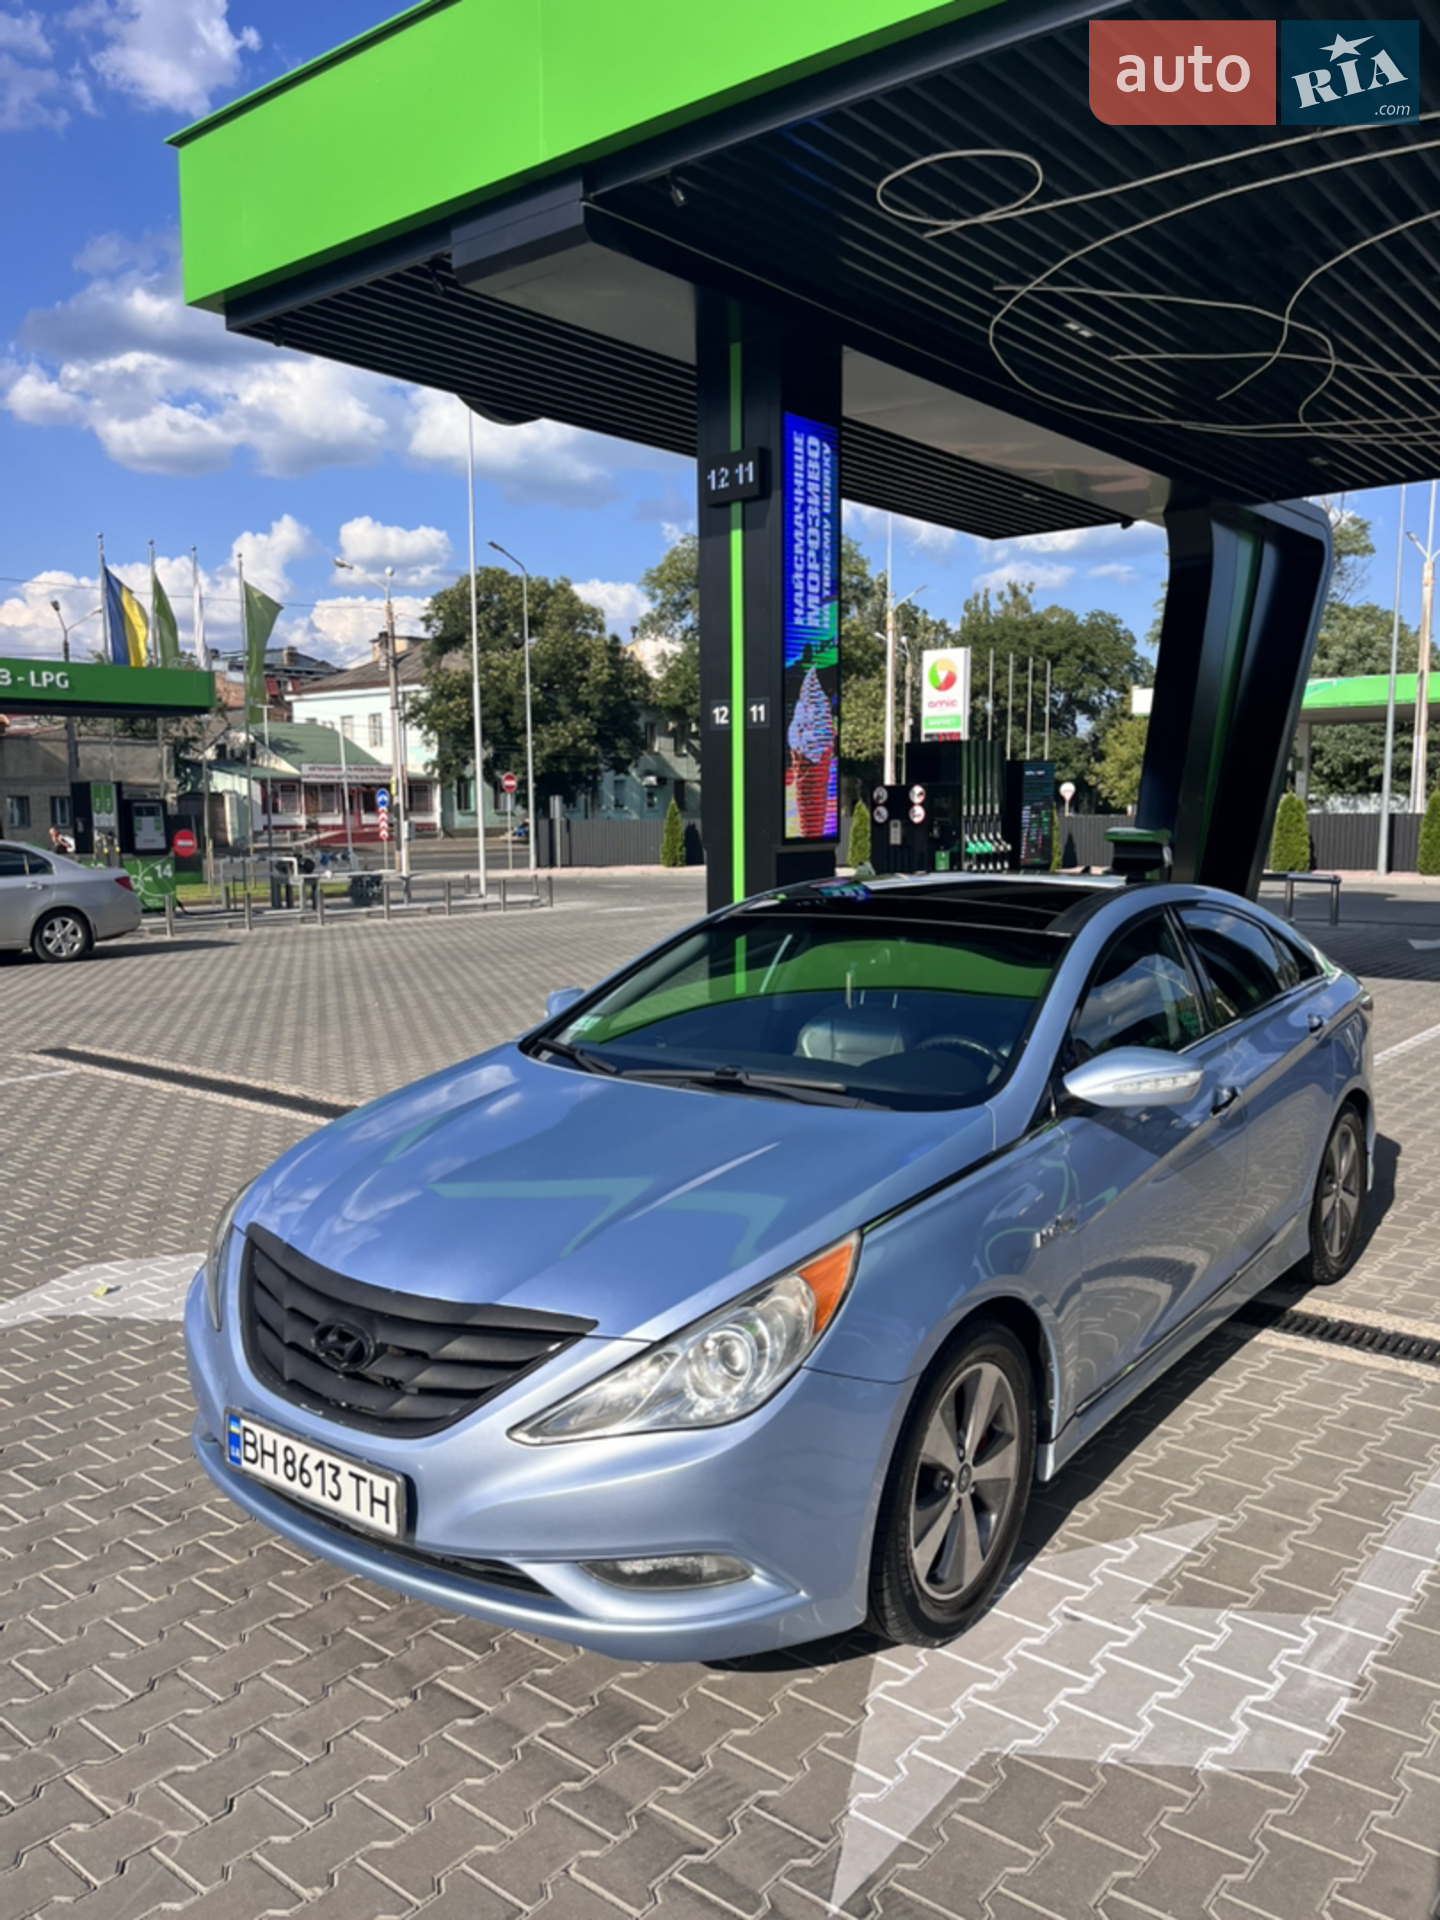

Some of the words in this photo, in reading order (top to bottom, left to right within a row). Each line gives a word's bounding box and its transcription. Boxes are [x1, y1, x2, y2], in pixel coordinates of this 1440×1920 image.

[707, 466, 730, 491] 12
[735, 460, 754, 485] 11
[806, 434, 821, 628] МОРОЗИВО
[29, 669, 70, 689] LPG
[712, 705, 730, 725] 12
[750, 703, 766, 723] 11
[155, 863, 173, 879] 14
[242, 1426, 279, 1476] BH
[283, 1445, 343, 1502] 8613
[348, 1470, 391, 1525] TH
